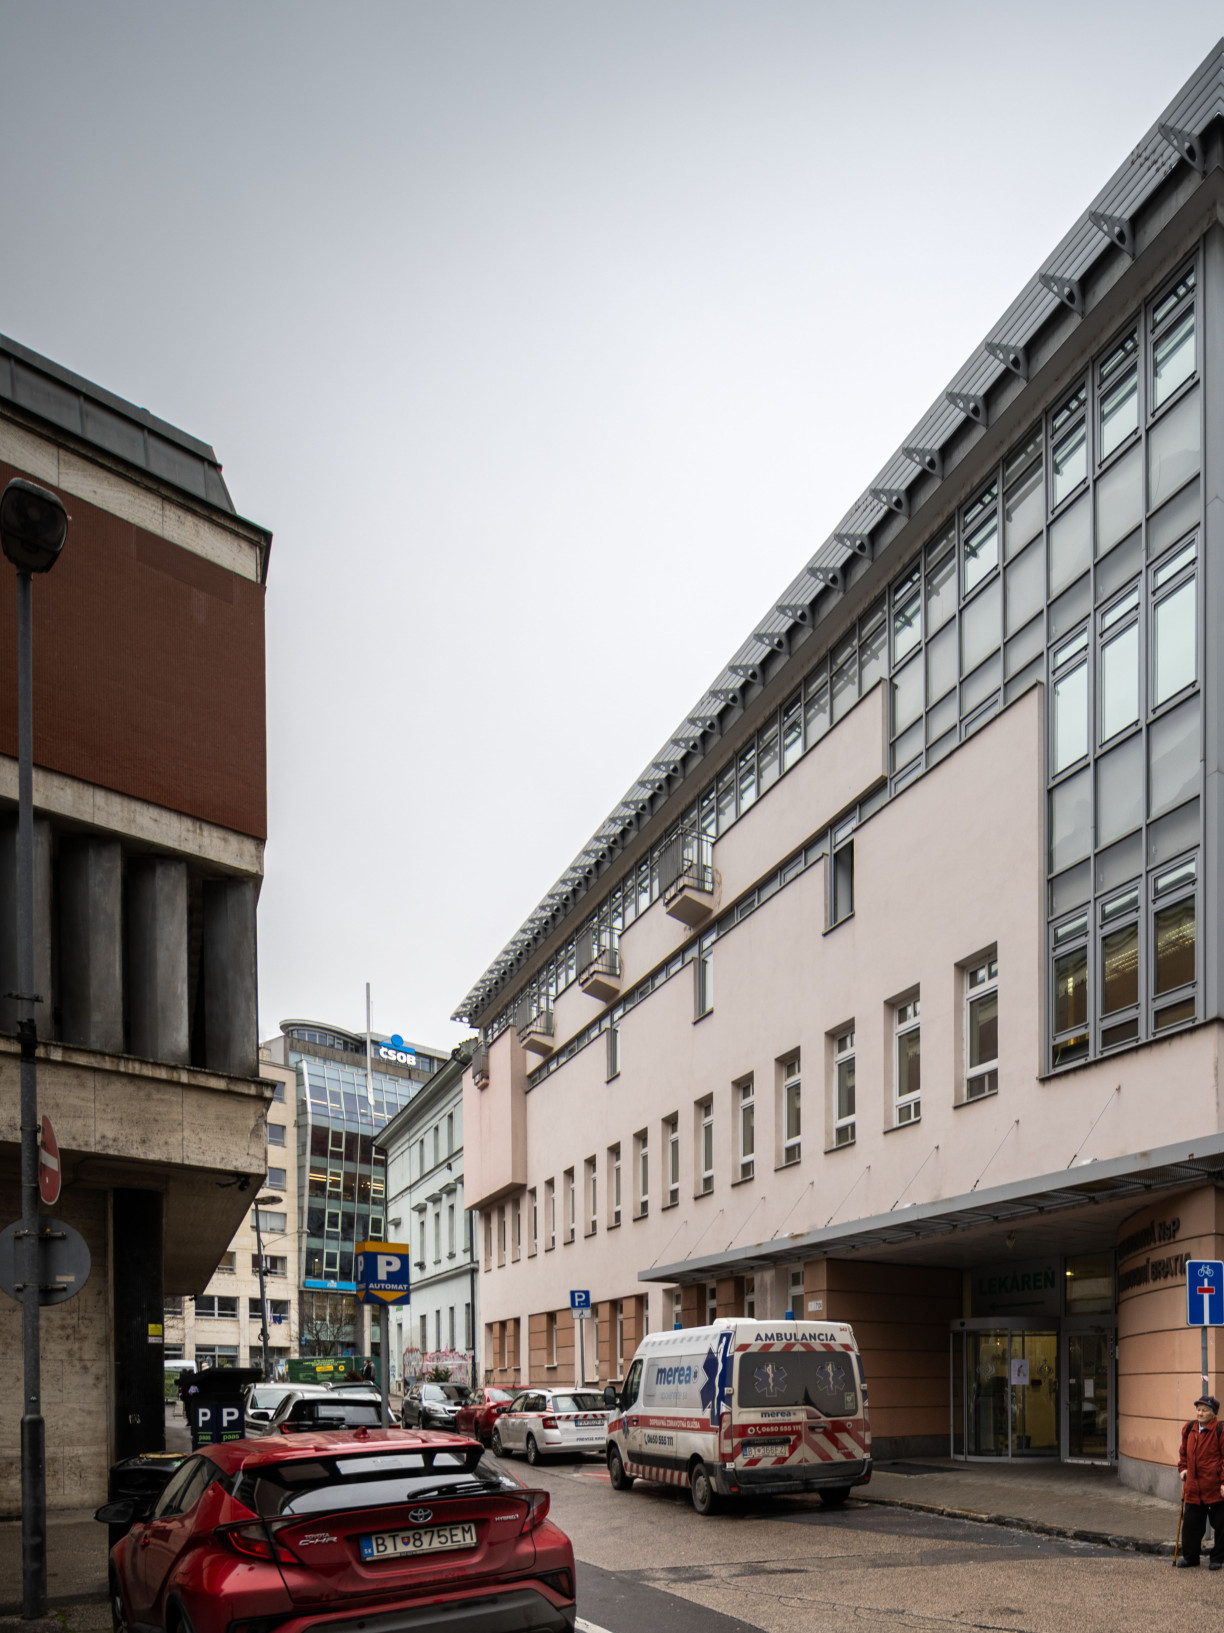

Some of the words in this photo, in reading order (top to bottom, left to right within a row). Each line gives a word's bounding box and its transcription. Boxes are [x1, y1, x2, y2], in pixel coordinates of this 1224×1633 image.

[379, 1046, 416, 1066] ČSOB
[377, 1254, 402, 1280] P
[979, 1266, 1055, 1296] LEKÁREŇ
[575, 1292, 586, 1307] P
[755, 1333, 837, 1342] AMBULANCIA
[656, 1366, 692, 1385] merea
[198, 1408, 211, 1427] P
[222, 1408, 239, 1427] P
[647, 1434, 658, 1444] 0650
[658, 1435, 667, 1445] 555
[299, 1536, 338, 1546] C-HR
[374, 1534, 399, 1554] BT
[412, 1525, 474, 1548] 875EM
